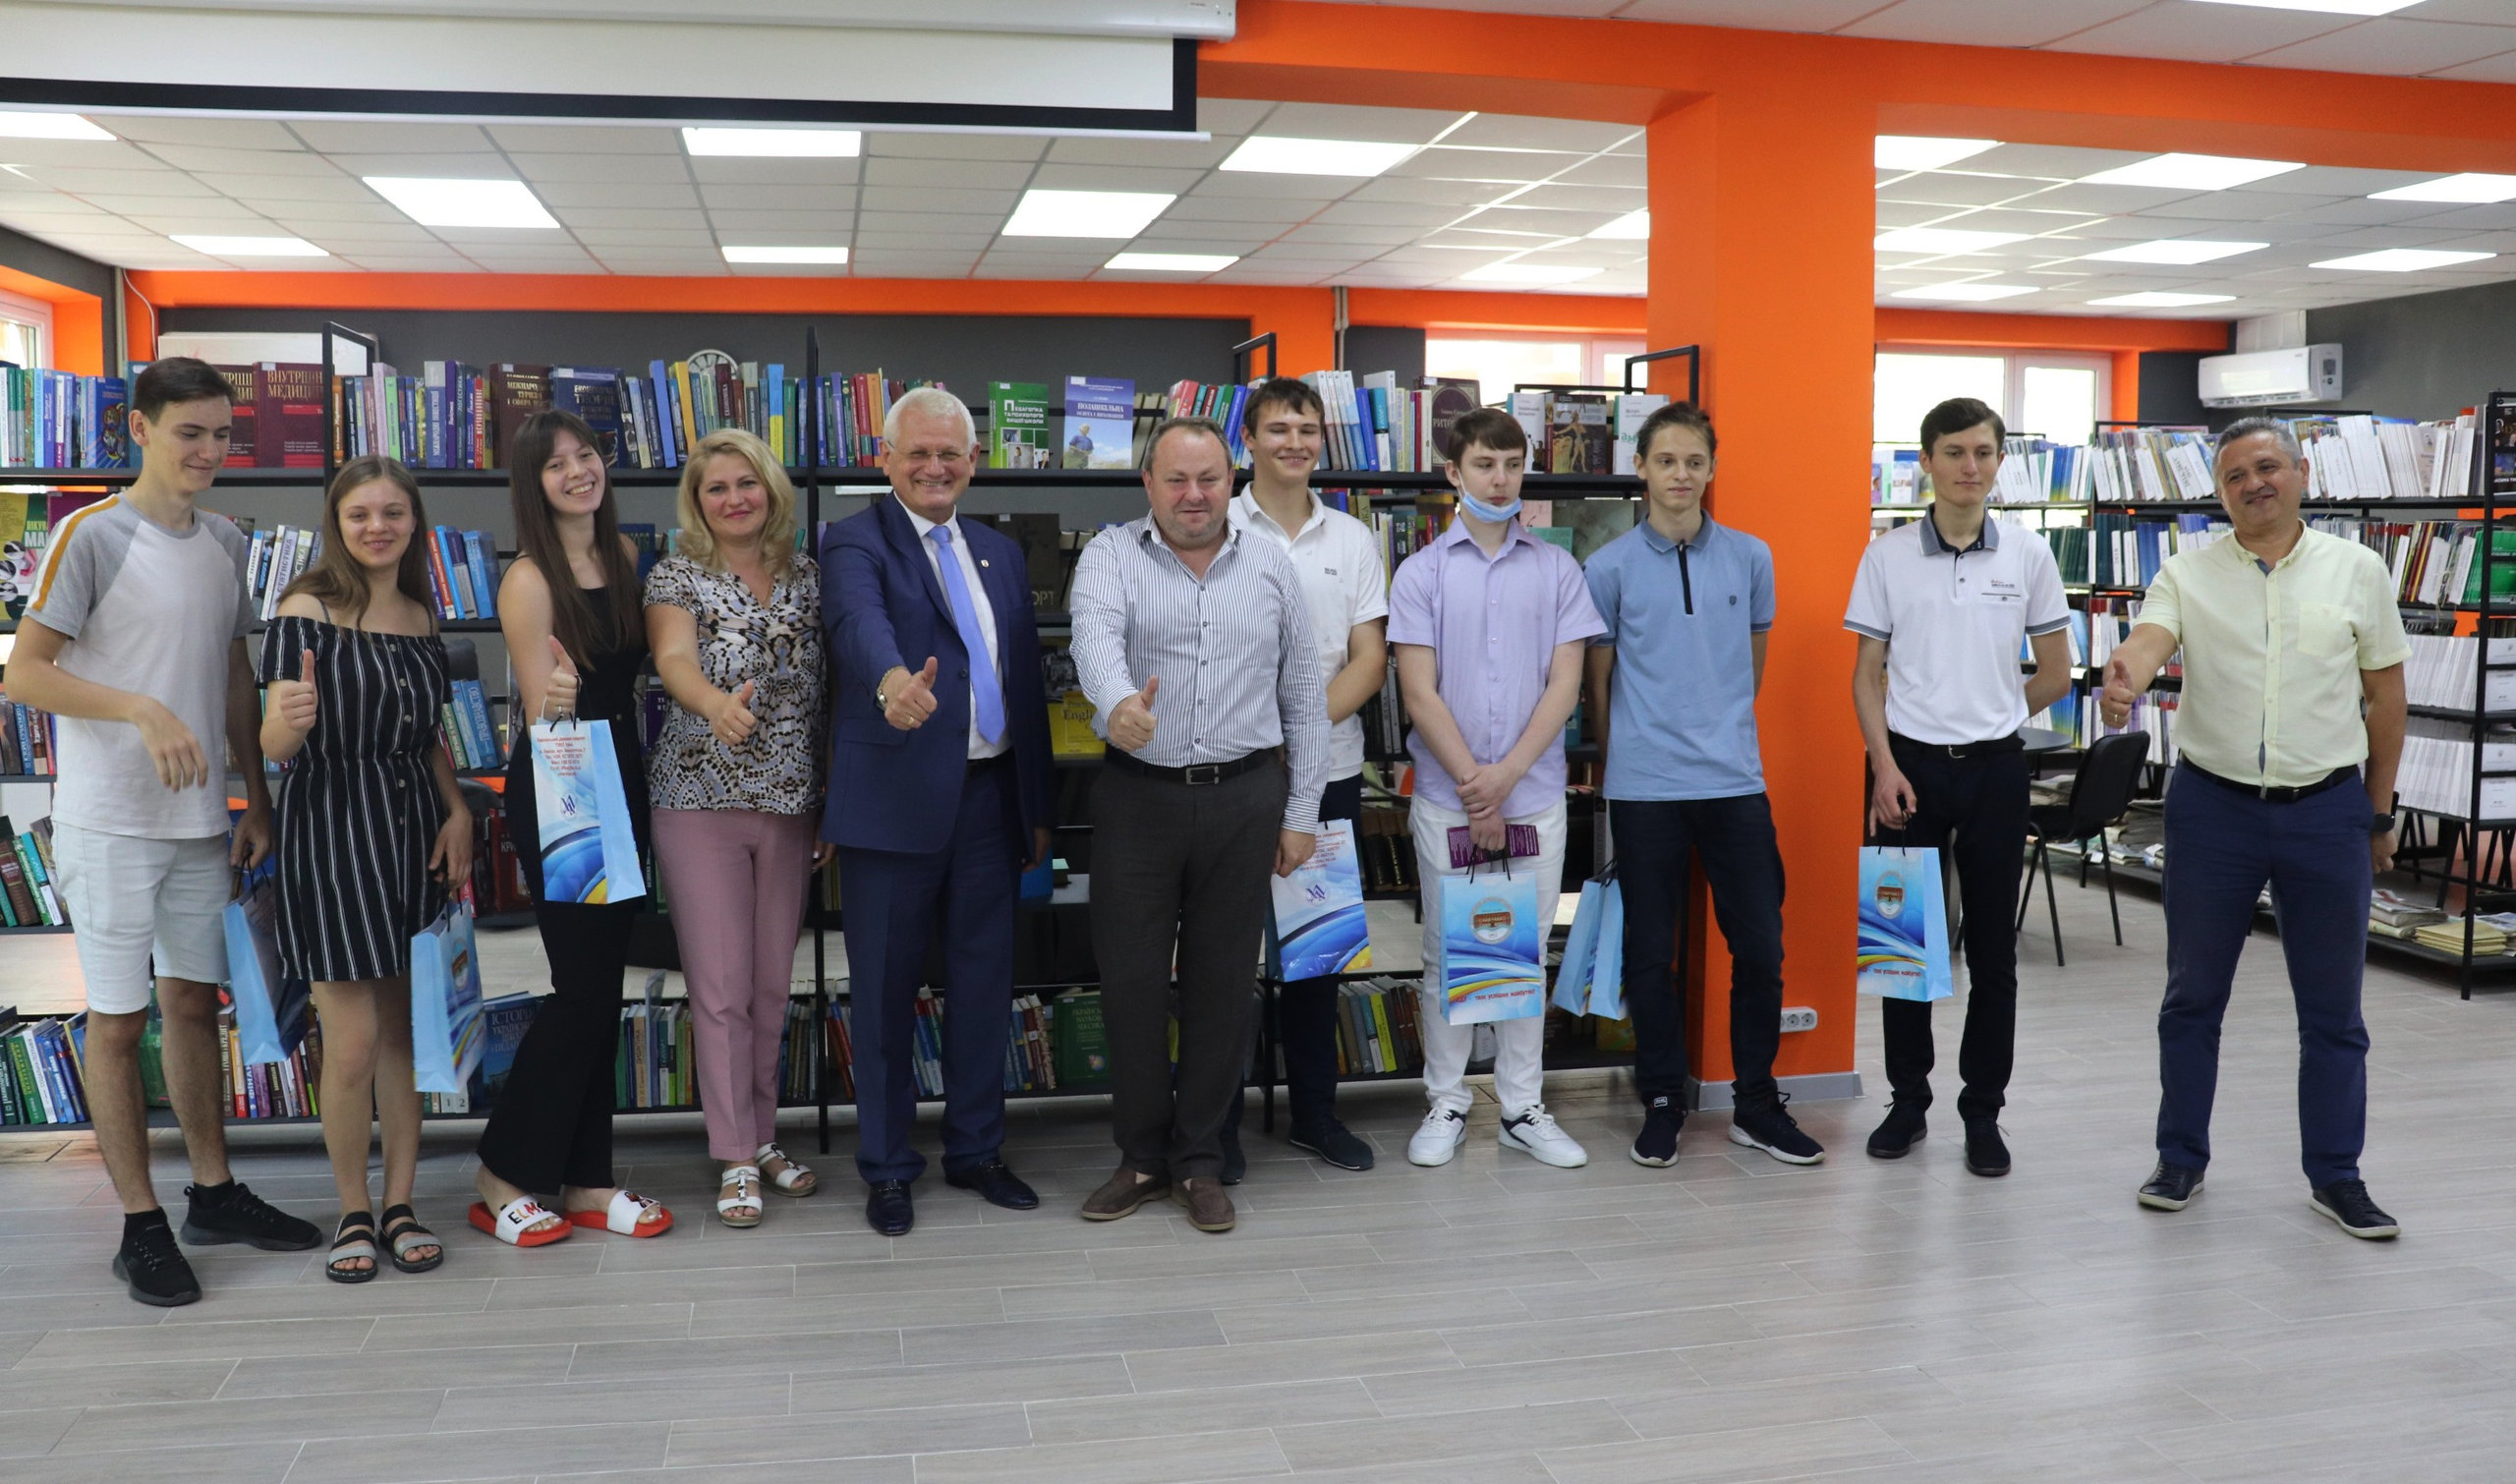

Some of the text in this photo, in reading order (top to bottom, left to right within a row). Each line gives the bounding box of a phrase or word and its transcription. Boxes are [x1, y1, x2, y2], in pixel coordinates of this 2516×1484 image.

[276, 538, 294, 594] СТАТИСТИКА
[468, 686, 489, 741] ПРАВОЗНАВСТВО
[459, 1098, 466, 1107] 2
